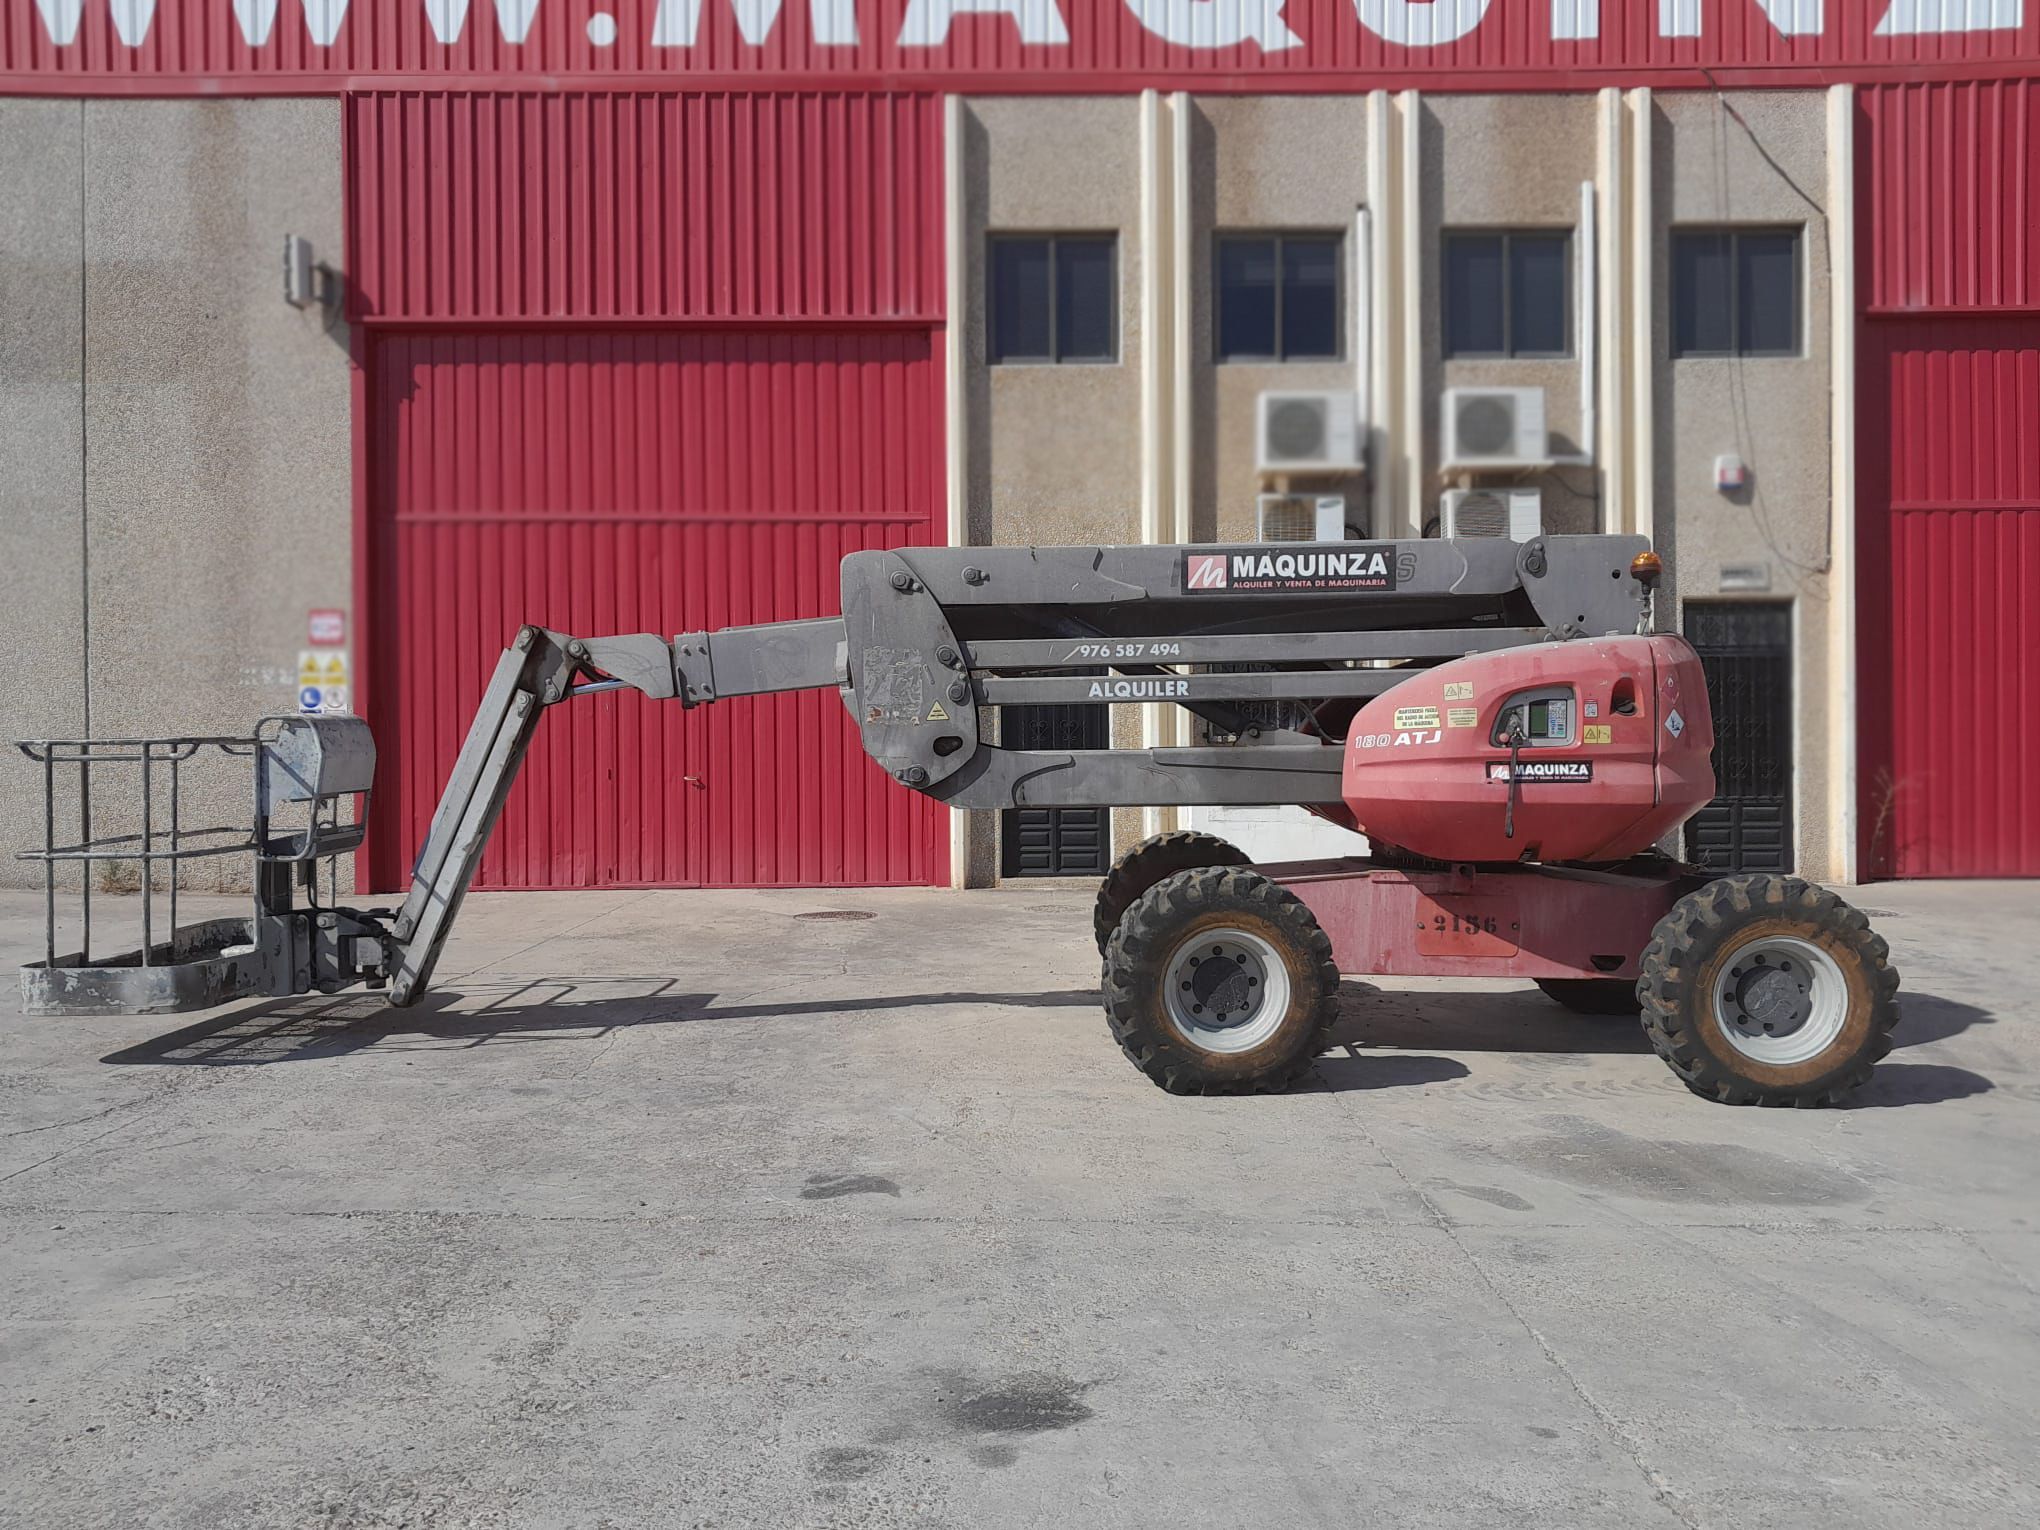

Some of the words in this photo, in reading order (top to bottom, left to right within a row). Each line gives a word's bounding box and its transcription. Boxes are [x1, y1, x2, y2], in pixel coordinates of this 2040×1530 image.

[1232, 553, 1388, 579] MAQUINZA
[1233, 581, 1273, 589] ALQUILER
[1276, 580, 1282, 588] Y
[1285, 580, 1312, 588] VENTA
[1315, 579, 1325, 587] DE
[1328, 578, 1387, 587] MAQUINARIA
[1080, 644, 1110, 657] 976
[1115, 644, 1144, 657] 587
[1150, 643, 1180, 656] 494
[1088, 680, 1189, 697] ALQUILER
[1355, 734, 1391, 748] 180
[1394, 730, 1442, 746] ATJ
[1514, 763, 1589, 775] MAQUINZA
[1433, 914, 1497, 935] 2156
